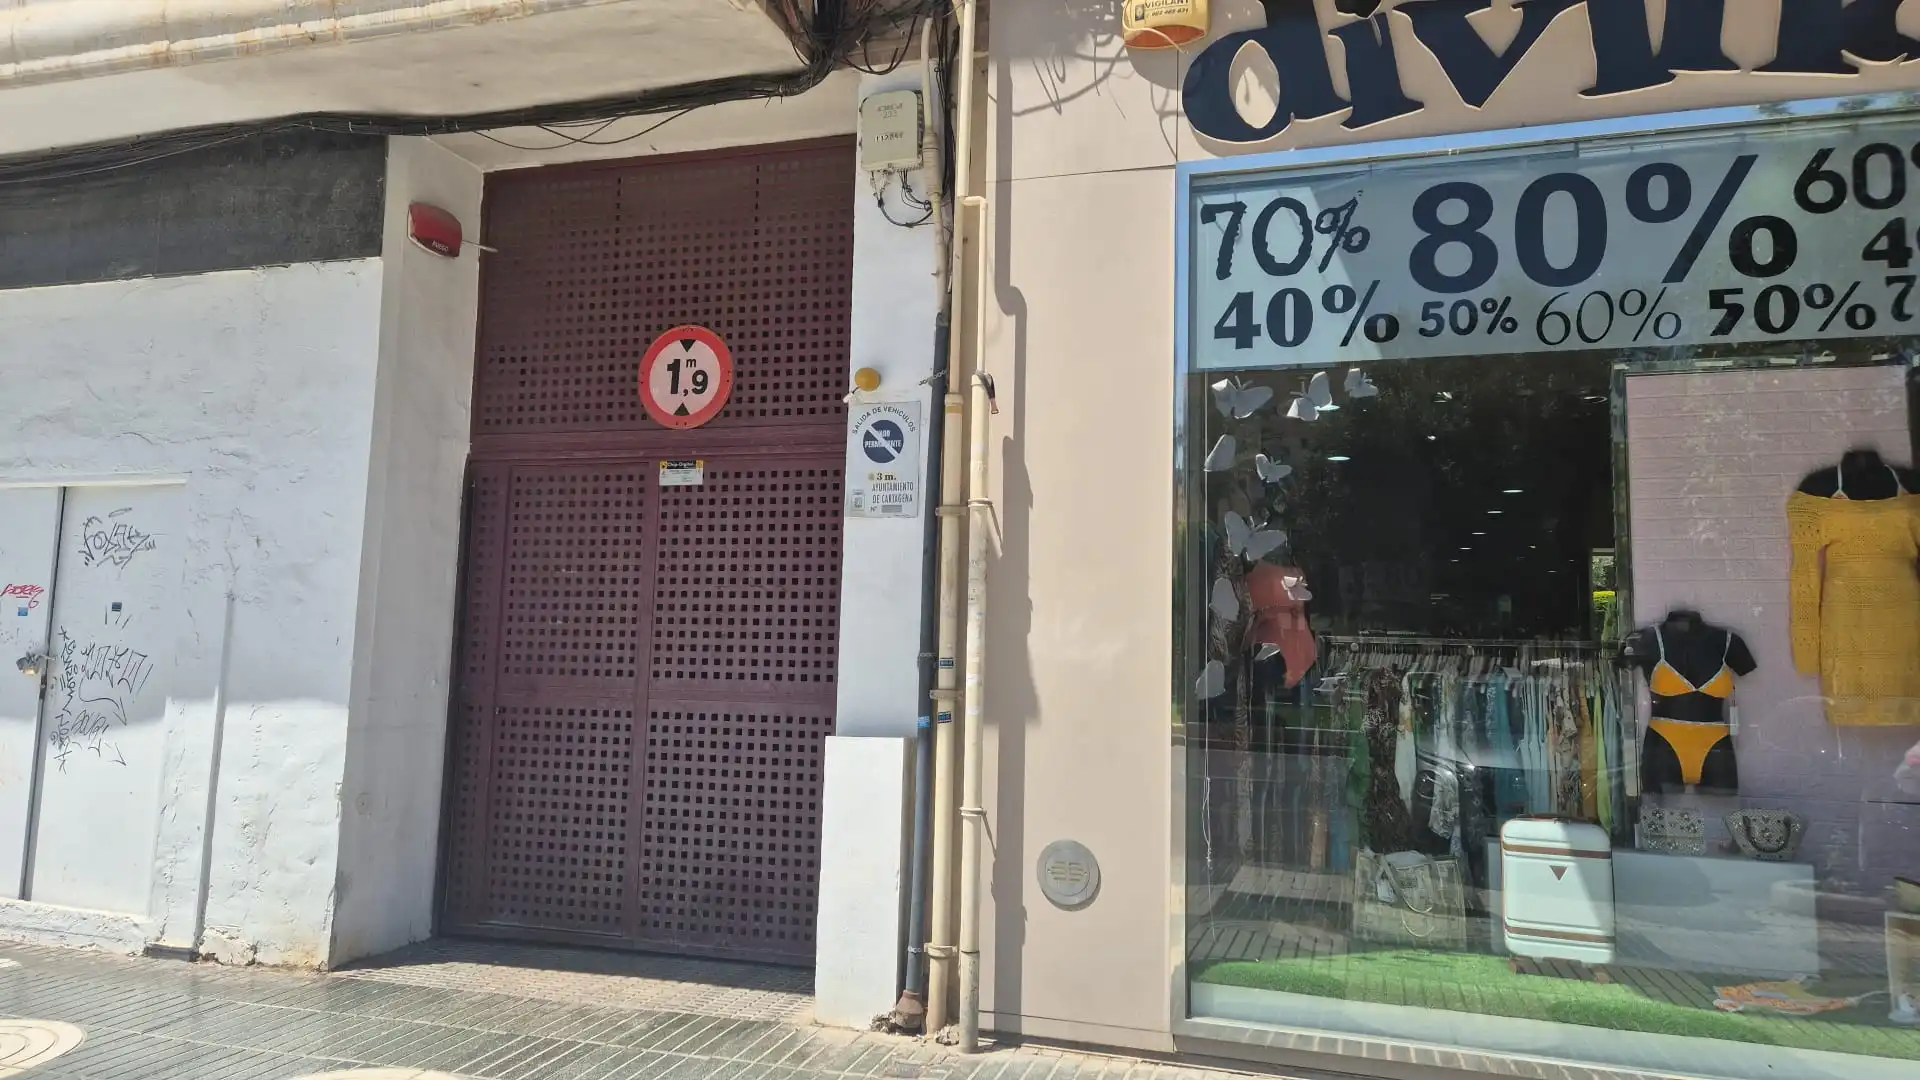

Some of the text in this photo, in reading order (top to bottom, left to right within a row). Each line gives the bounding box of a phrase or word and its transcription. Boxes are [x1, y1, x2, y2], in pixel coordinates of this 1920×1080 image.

[1793, 142, 1920, 214] 60
[1200, 154, 1798, 294] 70% 80%
[1213, 279, 1400, 351] 40%
[1418, 295, 1519, 338] 50%
[1534, 286, 1683, 346] 60%
[1707, 280, 1877, 335] 50%
[851, 405, 916, 435] SALIDA DE VEHICULOS
[871, 482, 914, 492] AYUNTAMIENTO
[876, 472, 883, 481] 3
[872, 494, 913, 504] DE CARTAGENA
